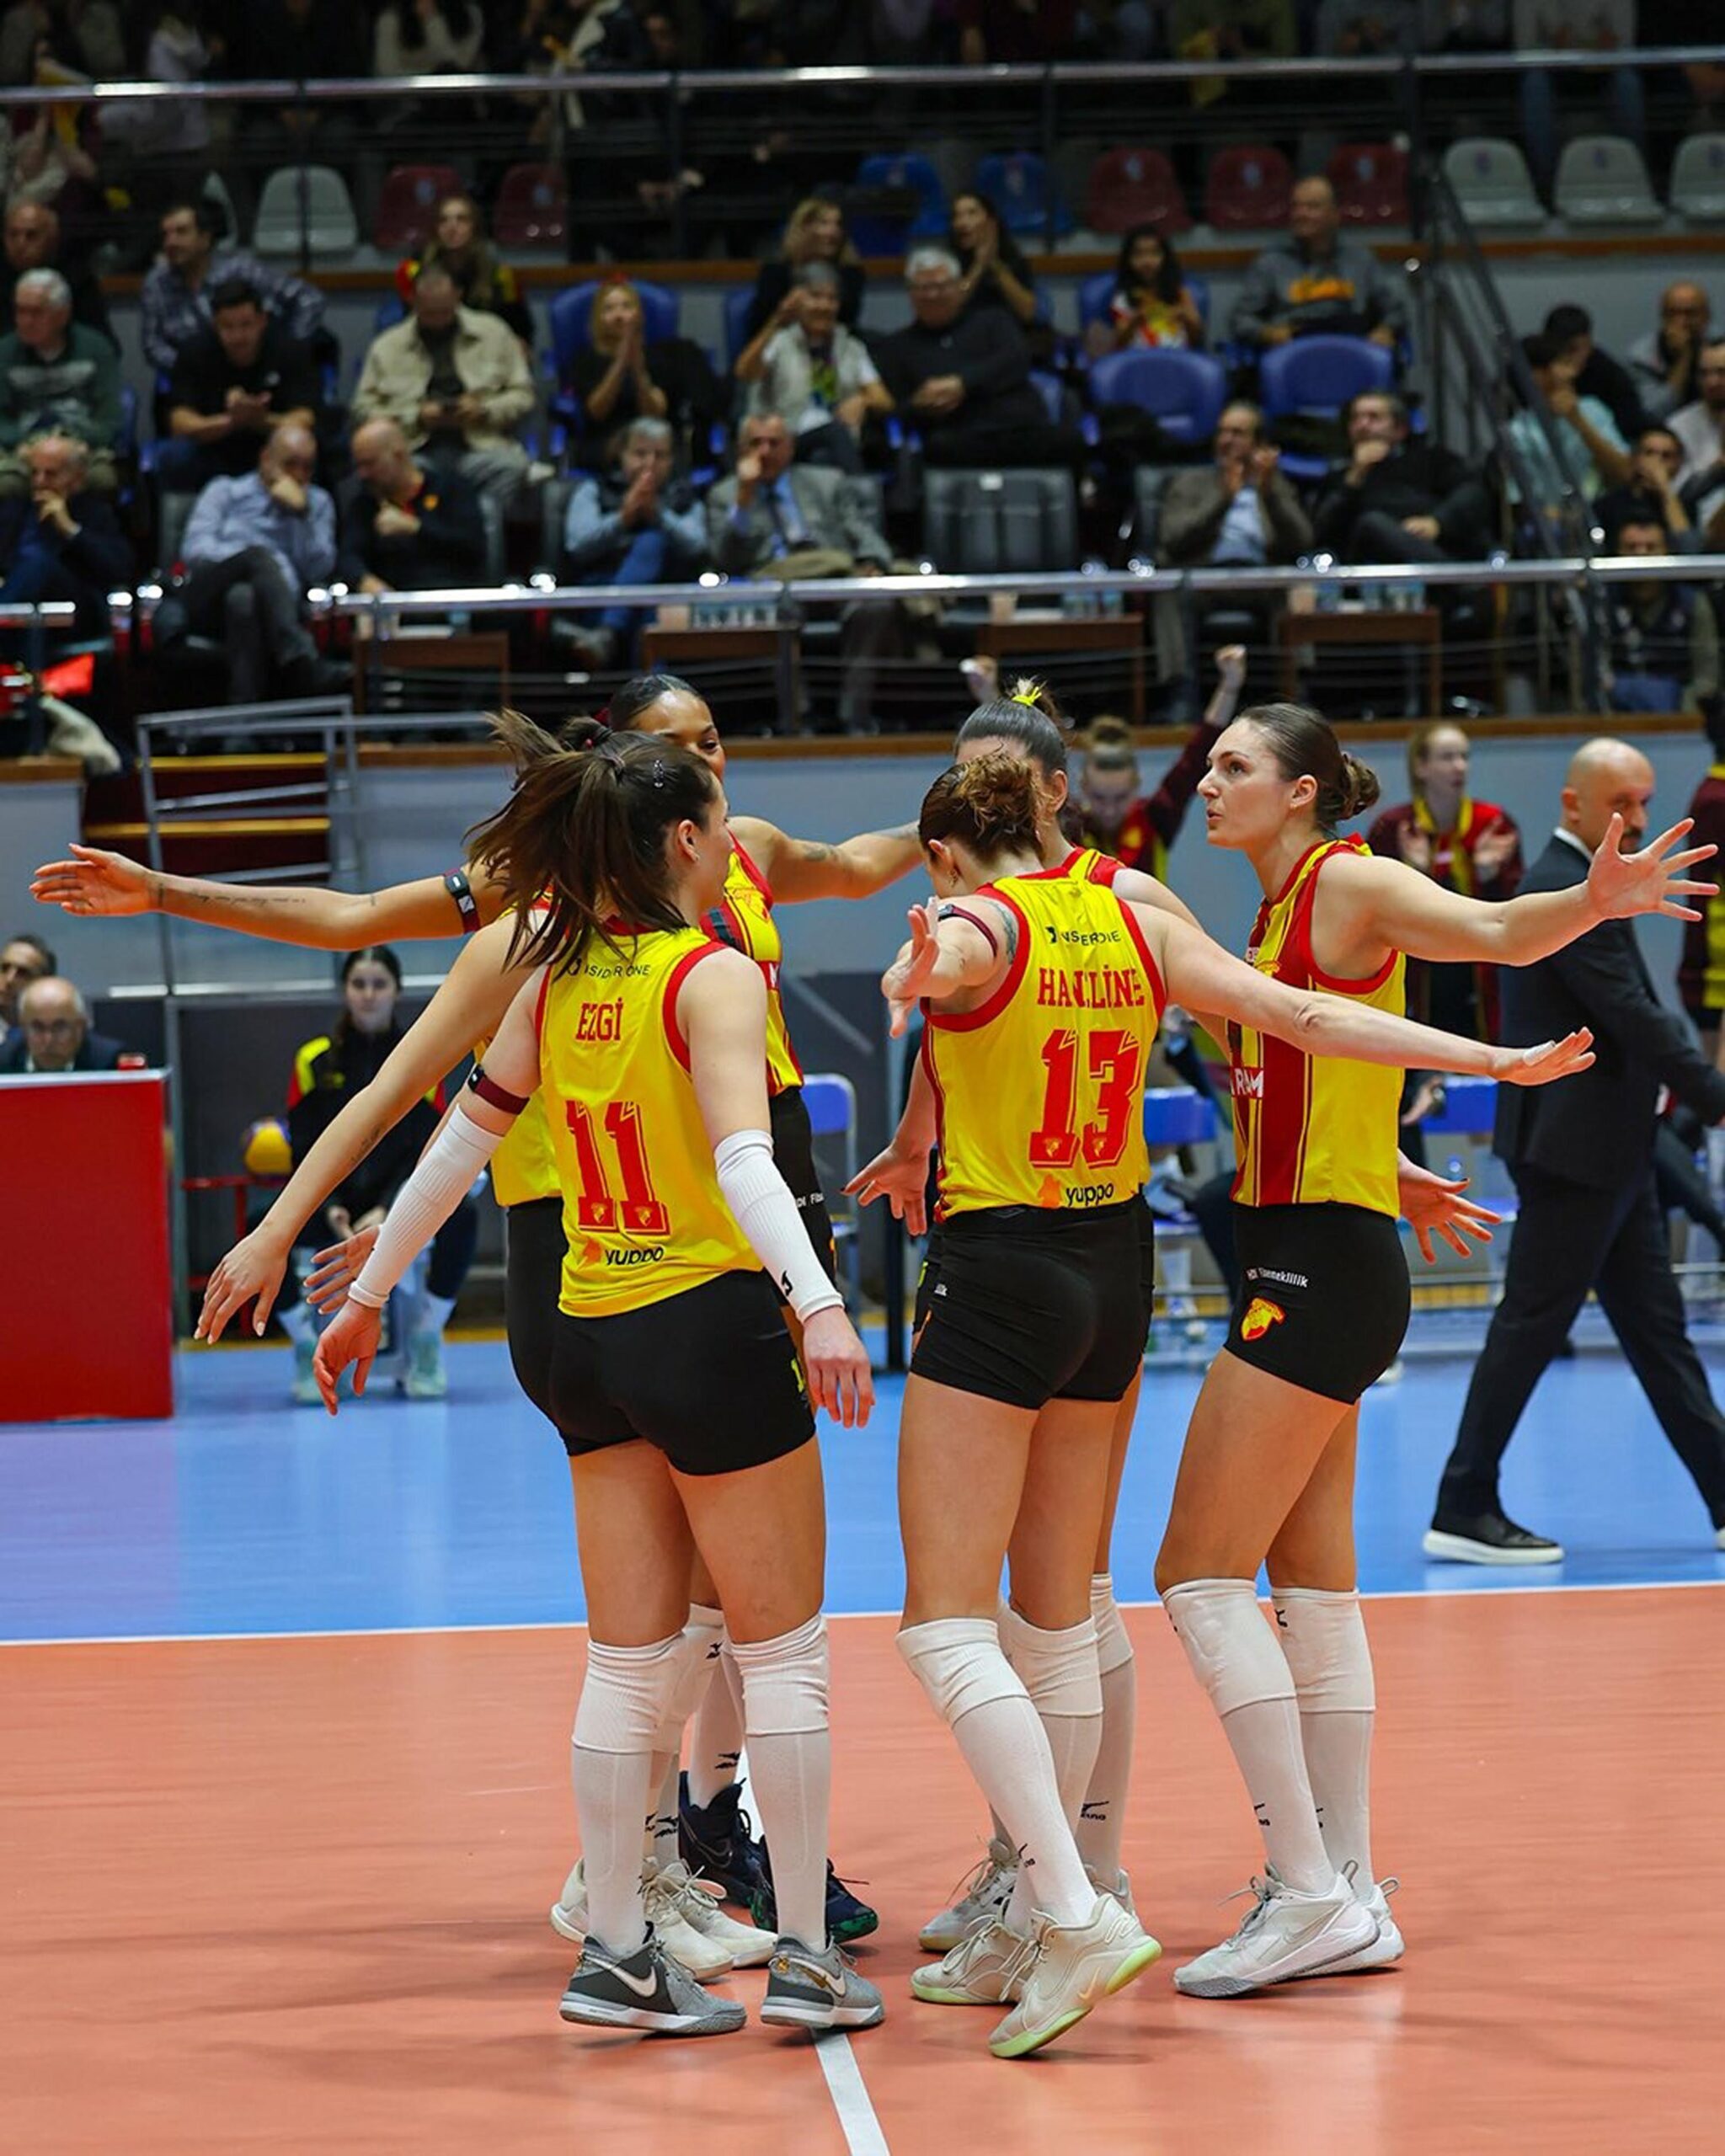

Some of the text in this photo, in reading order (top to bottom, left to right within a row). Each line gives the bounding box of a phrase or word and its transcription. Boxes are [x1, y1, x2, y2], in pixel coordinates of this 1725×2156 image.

[575, 996, 623, 1041] EZGİ
[1029, 1028, 1142, 1170] 13
[565, 1100, 671, 1235] 11
[1065, 1182, 1114, 1207] yuppo
